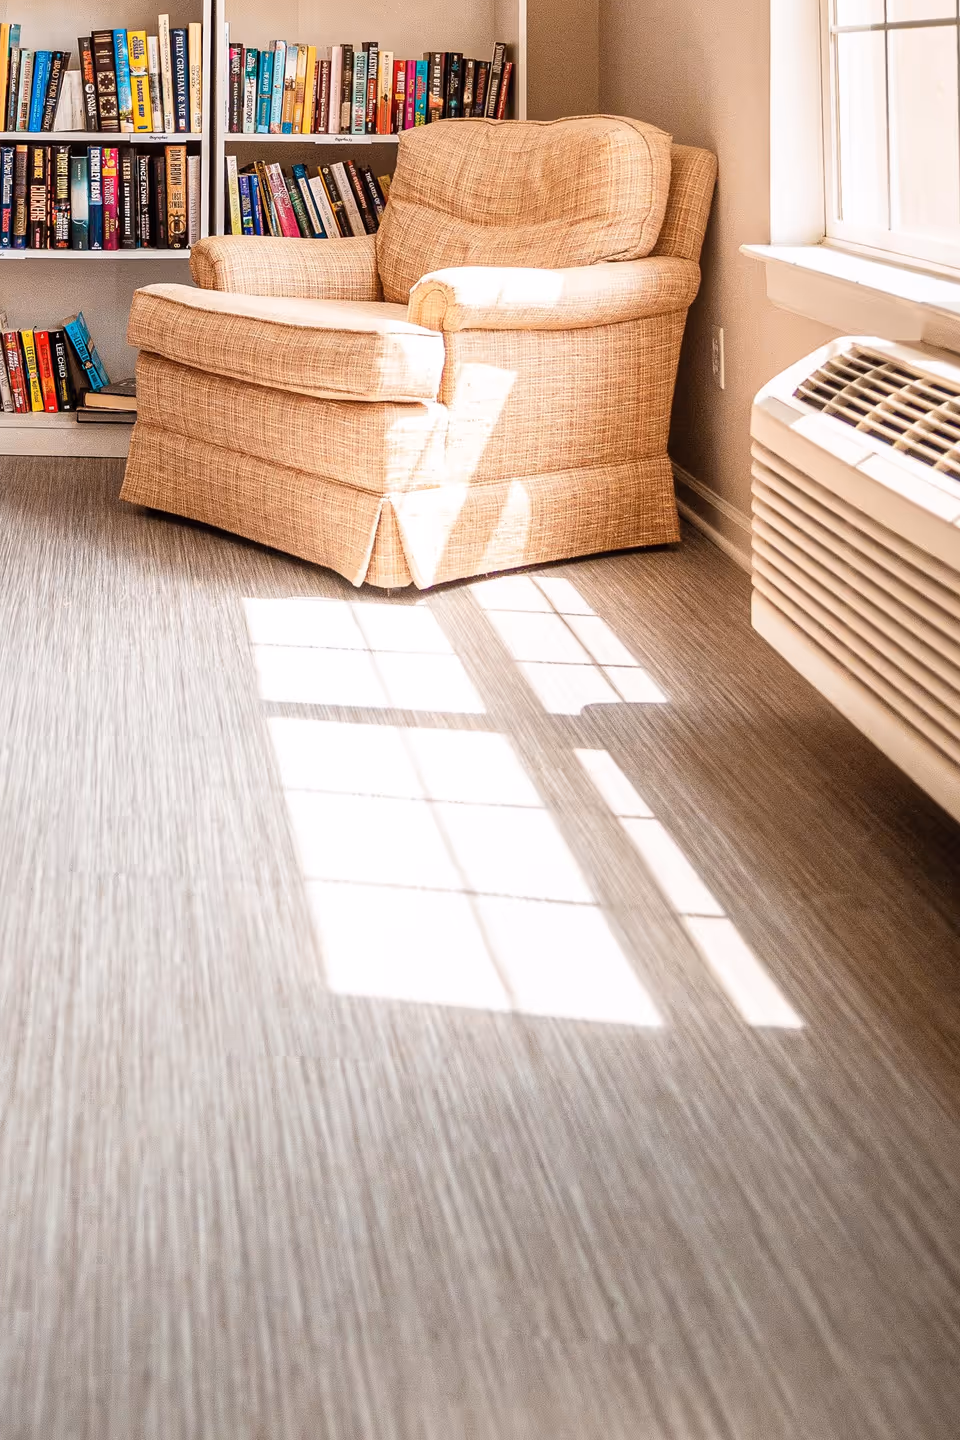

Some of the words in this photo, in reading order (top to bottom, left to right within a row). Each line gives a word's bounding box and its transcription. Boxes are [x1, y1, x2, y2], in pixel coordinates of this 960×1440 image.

[176, 36, 184, 58] BILLY
[52, 60, 61, 78] BRAD
[356, 56, 364, 80] STEPHEN
[369, 47, 378, 79] BLACKSTOCK
[434, 66, 442, 77] END
[176, 58, 185, 94] GRAHAM
[48, 80, 58, 98] THOR
[356, 82, 364, 104] HUNTER
[432, 87, 441, 102] DAYS
[490, 79, 498, 95] THOMAS
[178, 104, 185, 116] ME
[4, 152, 13, 162] The
[57, 154, 68, 175] ROBERT
[91, 150, 100, 181] BENCHLEY
[170, 150, 182, 161] DAN
[4, 162, 12, 174] New
[170, 164, 182, 186] BROWN
[3, 175, 12, 204] Millennium
[57, 176, 68, 199] LUDLUM
[91, 182, 100, 201] BEAST
[368, 182, 377, 197] GATES
[30, 185, 46, 220] CLOCKERS
[2, 208, 11, 232] Robertson
[16, 198, 24, 234] ROBERTSON
[56, 343, 64, 356] LEE
[74, 338, 82, 346] LEE
[78, 346, 89, 360] CHILD
[58, 357, 66, 377] CHILD
